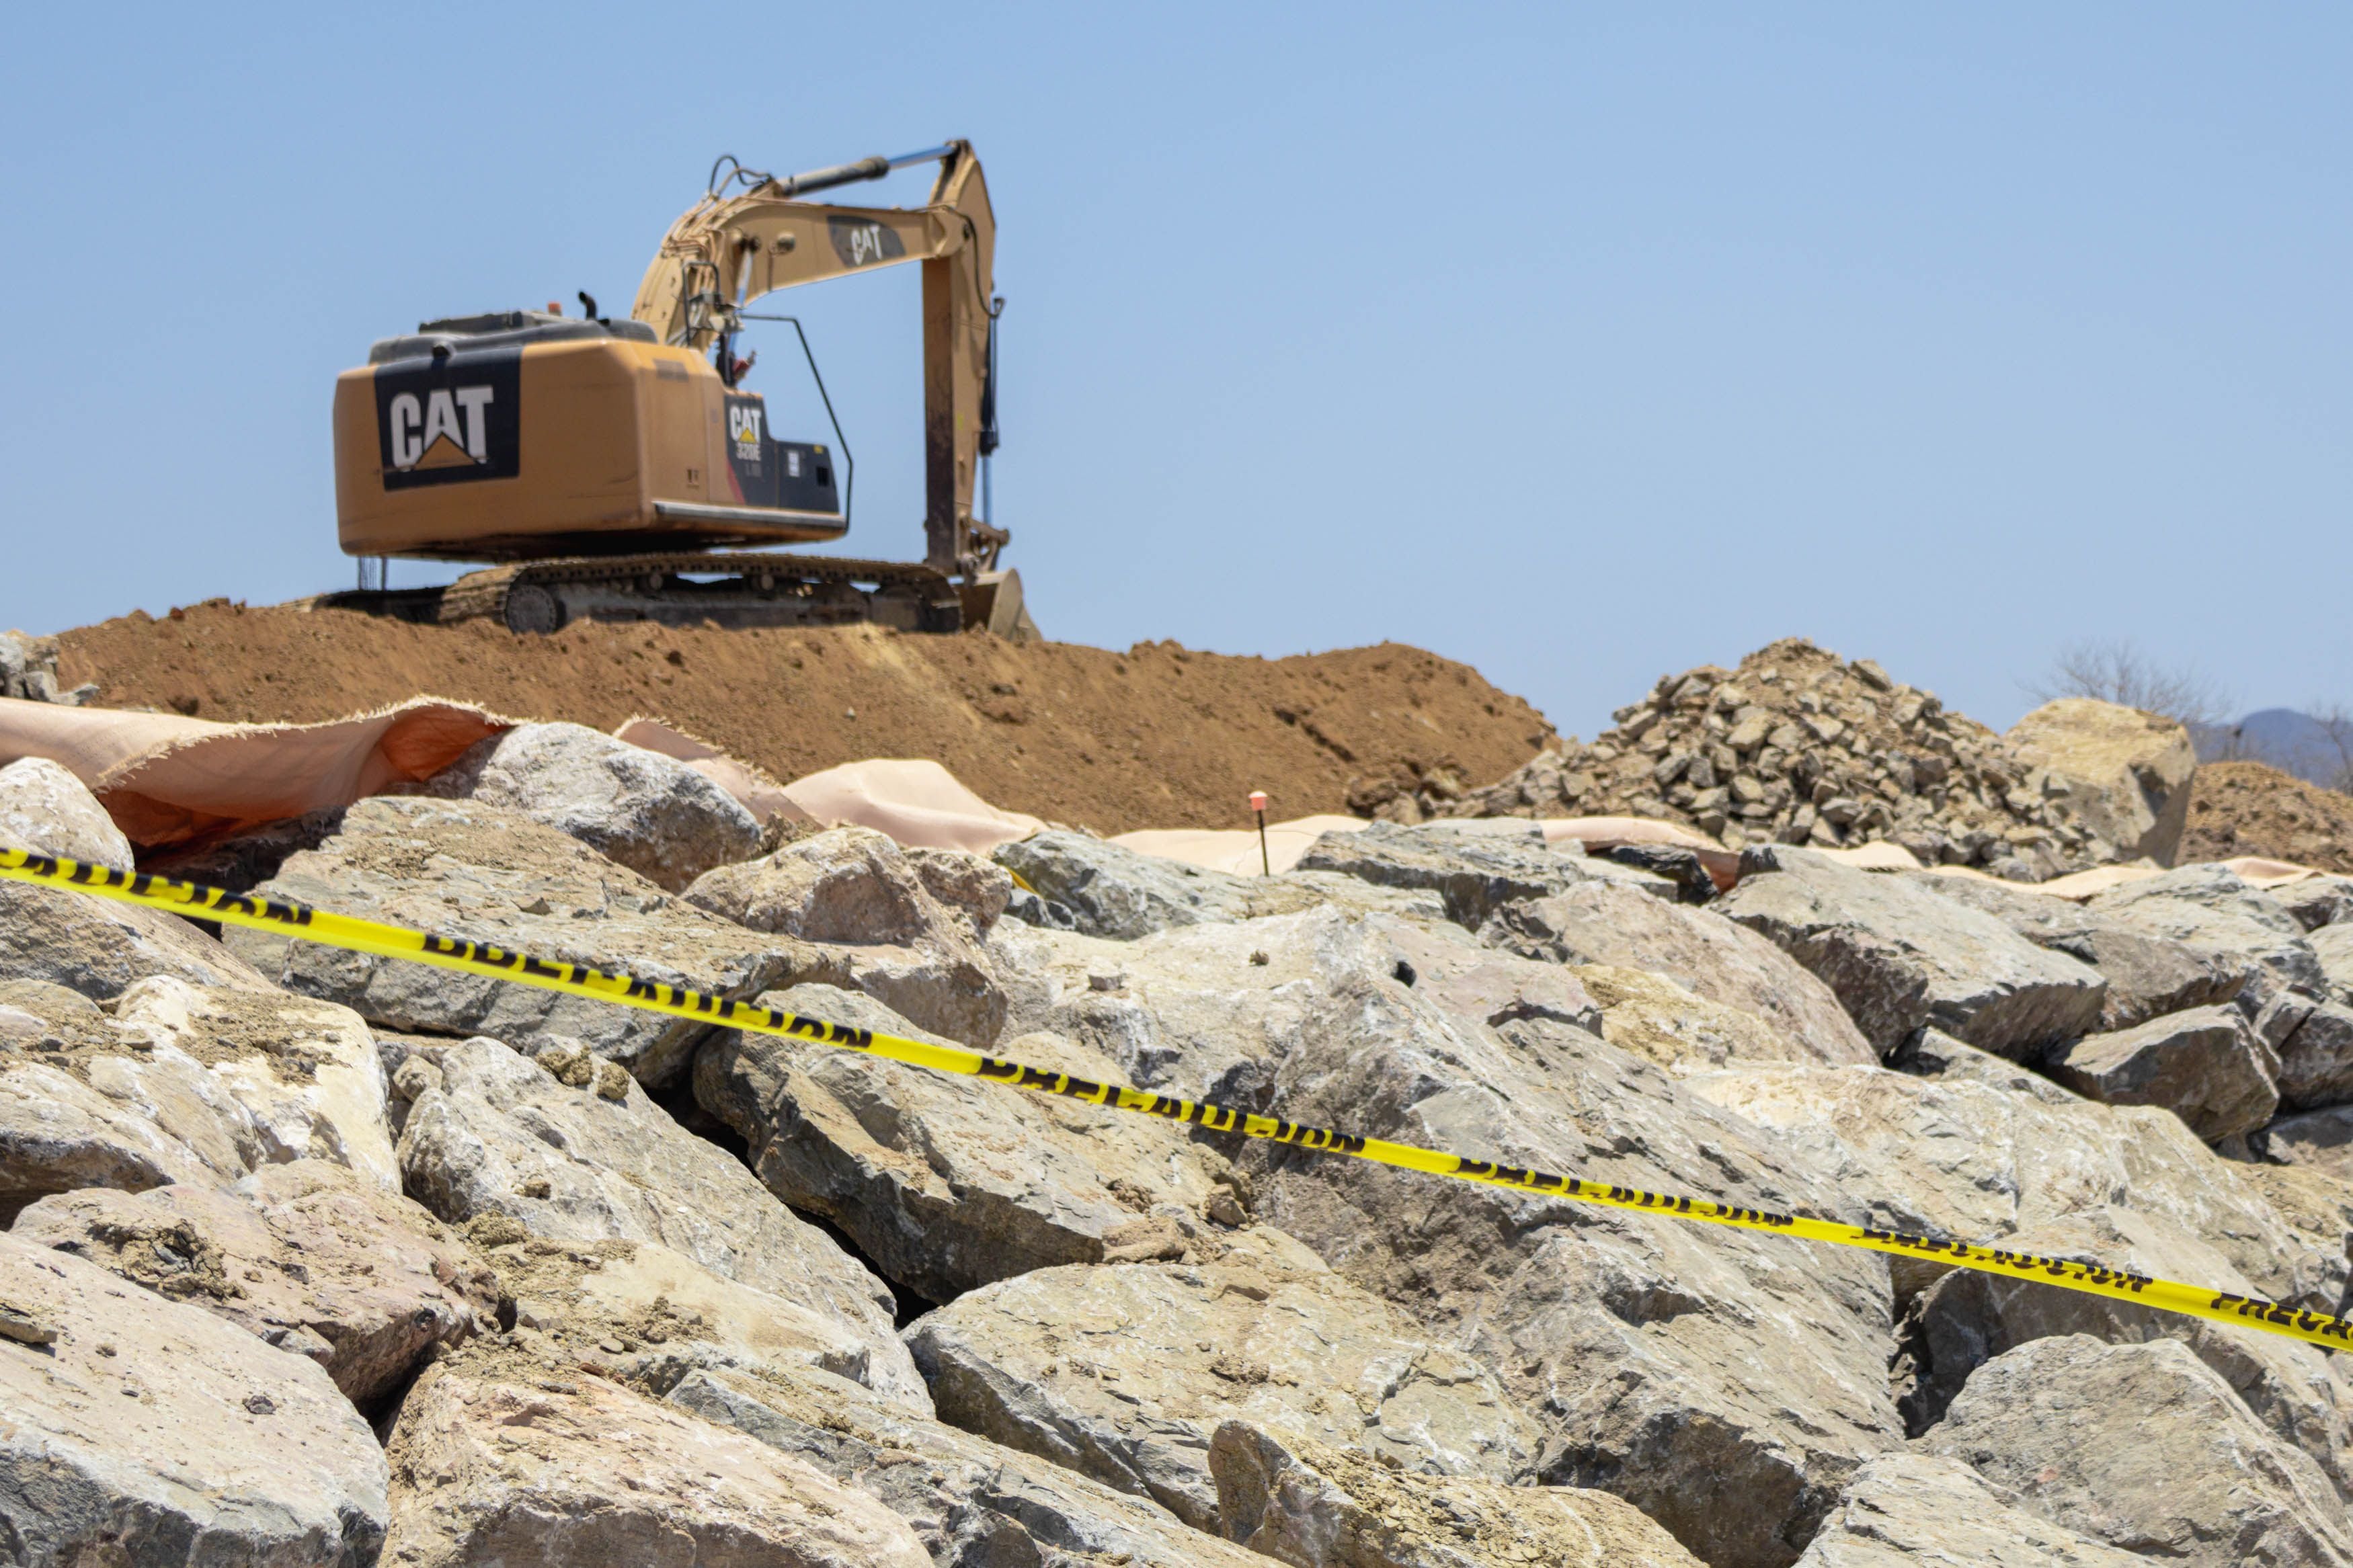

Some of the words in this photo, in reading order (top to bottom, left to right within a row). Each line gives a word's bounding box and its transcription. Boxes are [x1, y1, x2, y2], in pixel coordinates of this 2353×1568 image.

[851, 224, 882, 265] CAT
[390, 384, 494, 472] CAT
[729, 405, 761, 444] CAT
